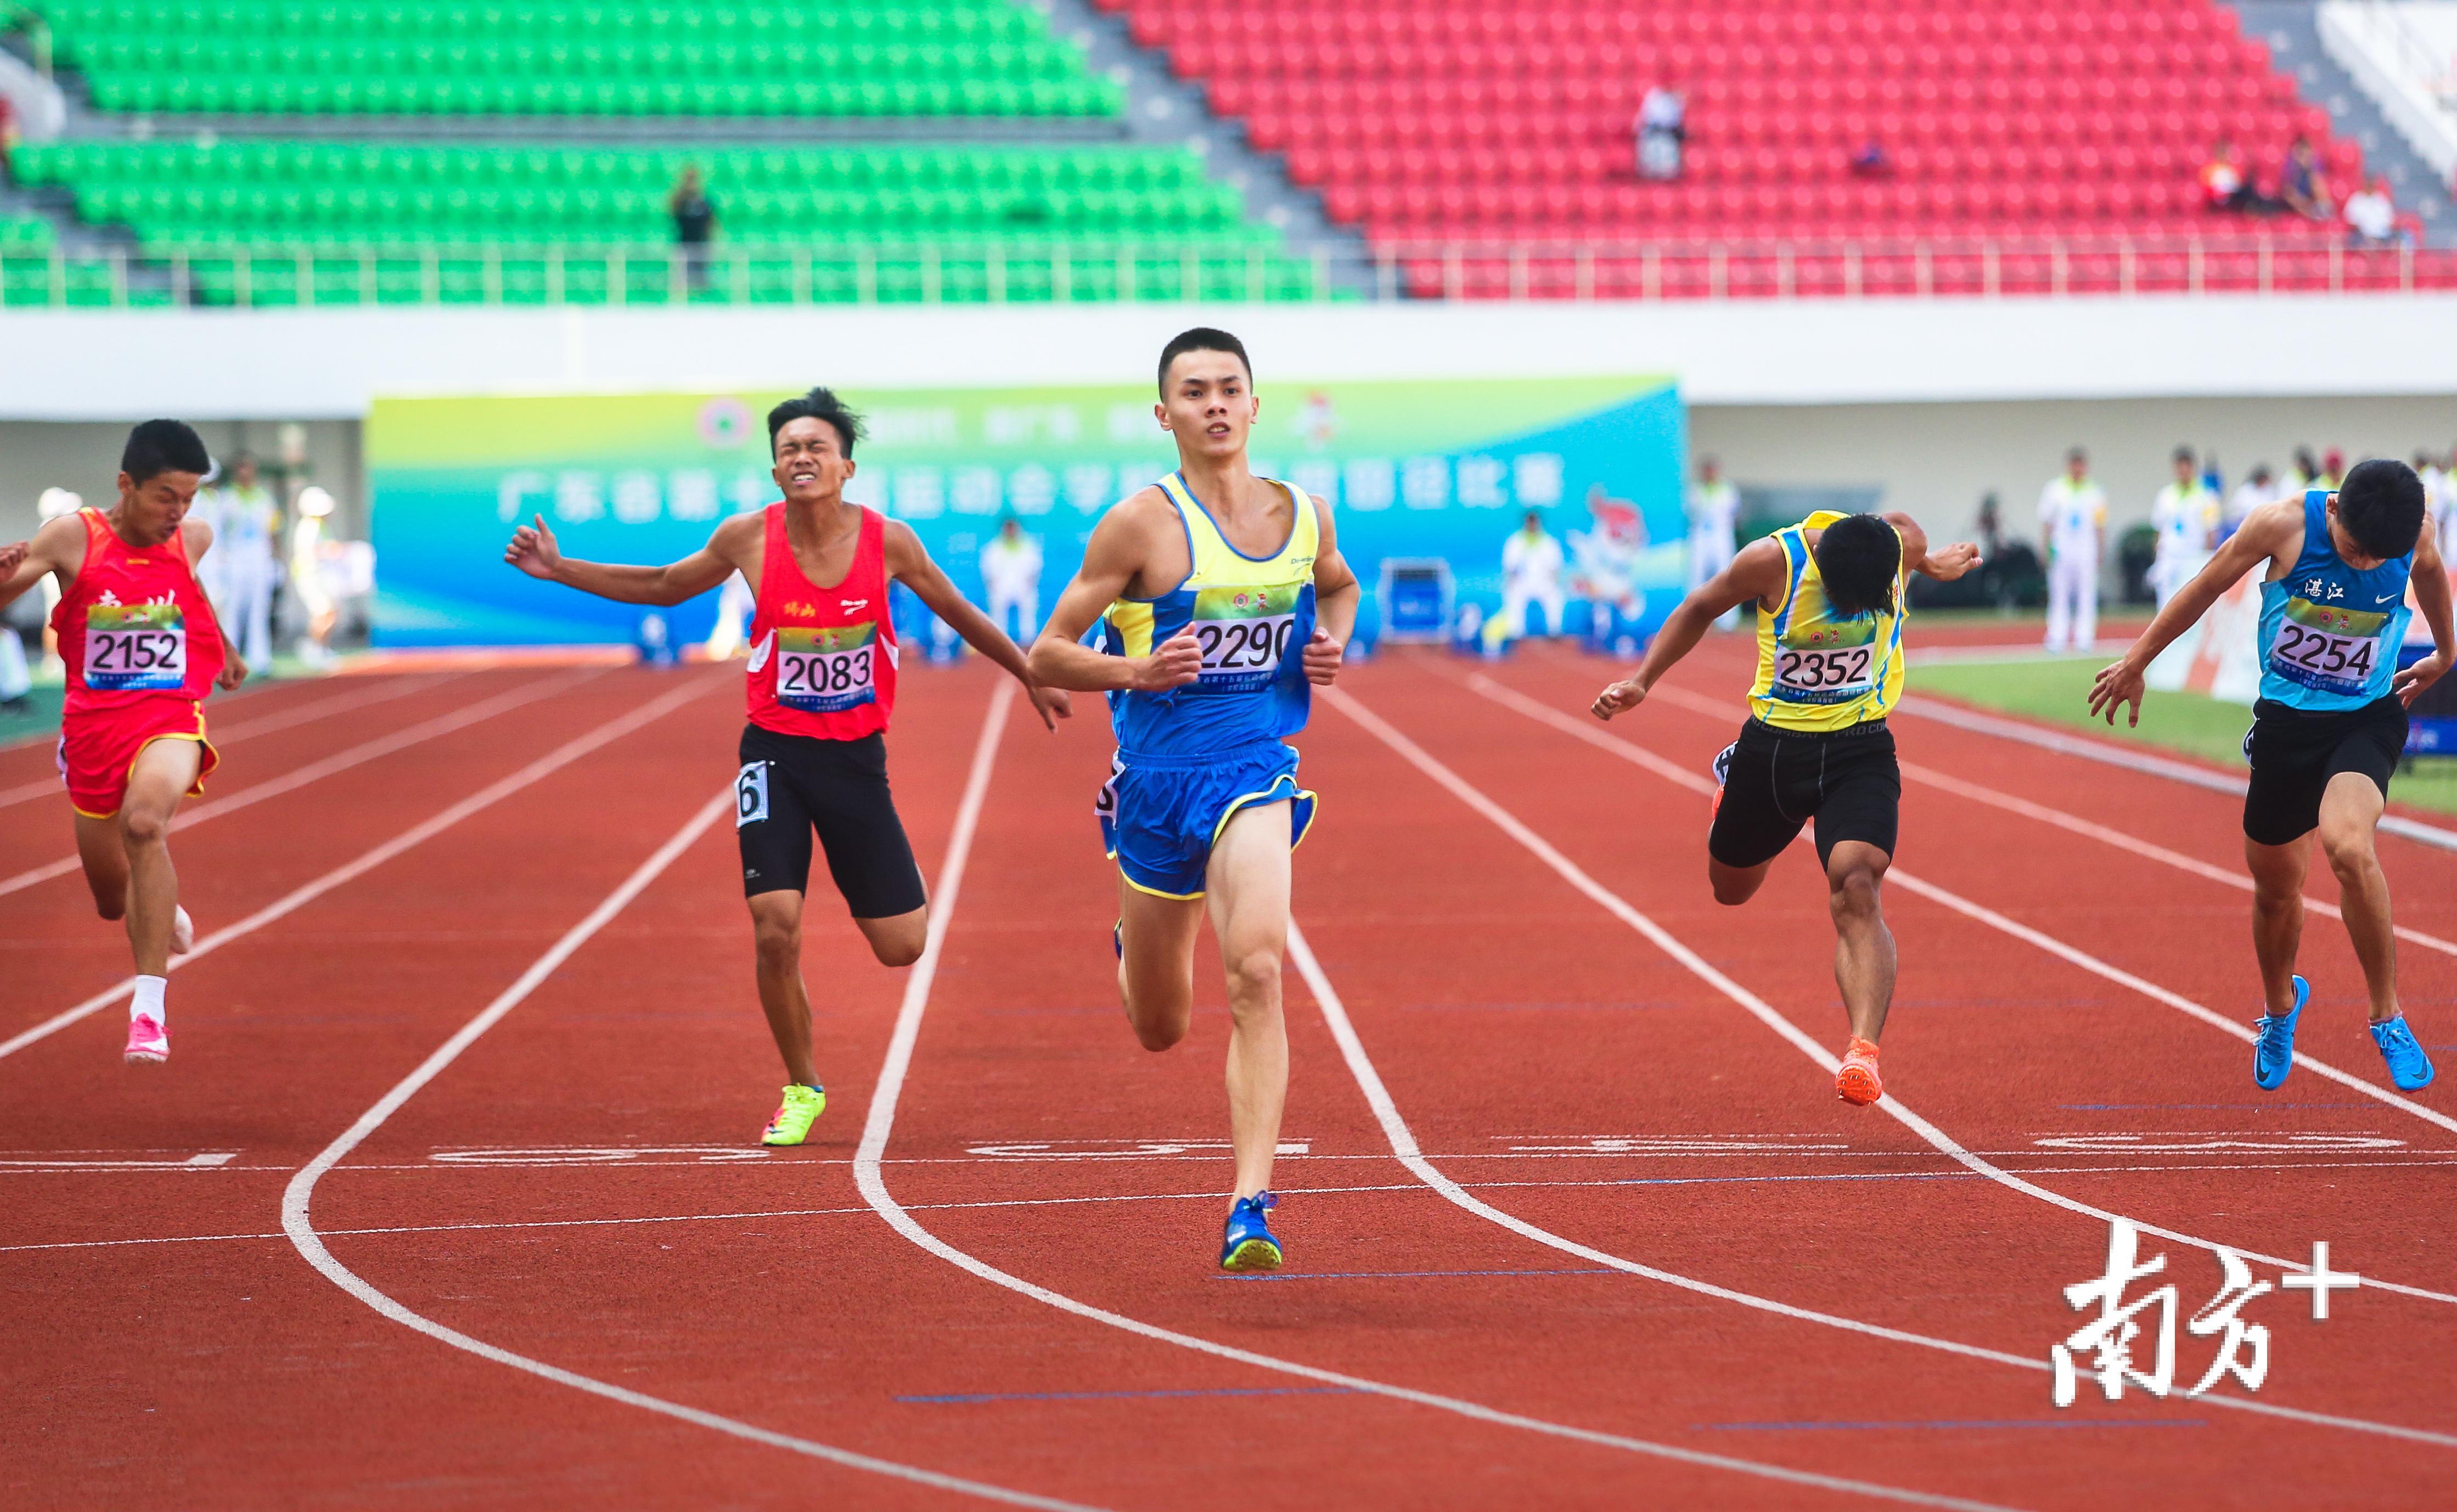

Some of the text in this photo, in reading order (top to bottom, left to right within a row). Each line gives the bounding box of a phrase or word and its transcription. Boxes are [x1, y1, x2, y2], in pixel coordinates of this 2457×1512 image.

[2305, 578, 2344, 600] 湛江
[93, 634, 178, 668] 2152
[1197, 619, 1294, 668] 2290
[2278, 625, 2372, 676] 2254
[784, 650, 870, 692] 2083
[1780, 649, 1870, 687] 2352
[739, 771, 759, 817] 6
